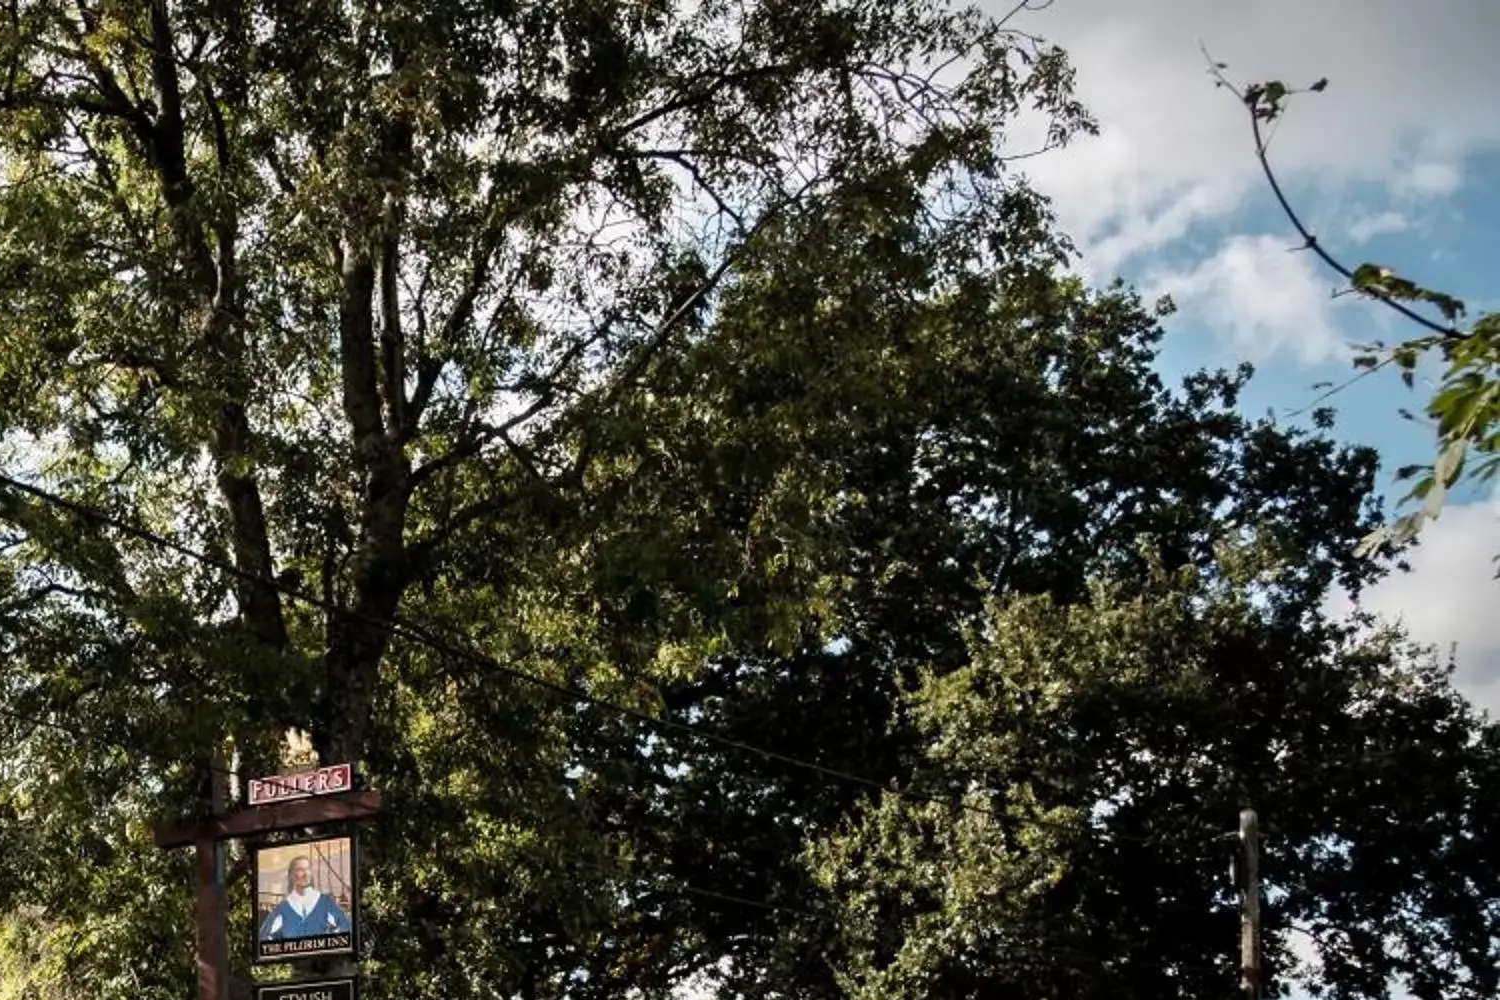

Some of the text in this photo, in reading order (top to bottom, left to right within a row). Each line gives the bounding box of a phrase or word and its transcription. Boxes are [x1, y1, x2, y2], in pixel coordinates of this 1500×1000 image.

[261, 935, 349, 955] THE PILGRIM INN
